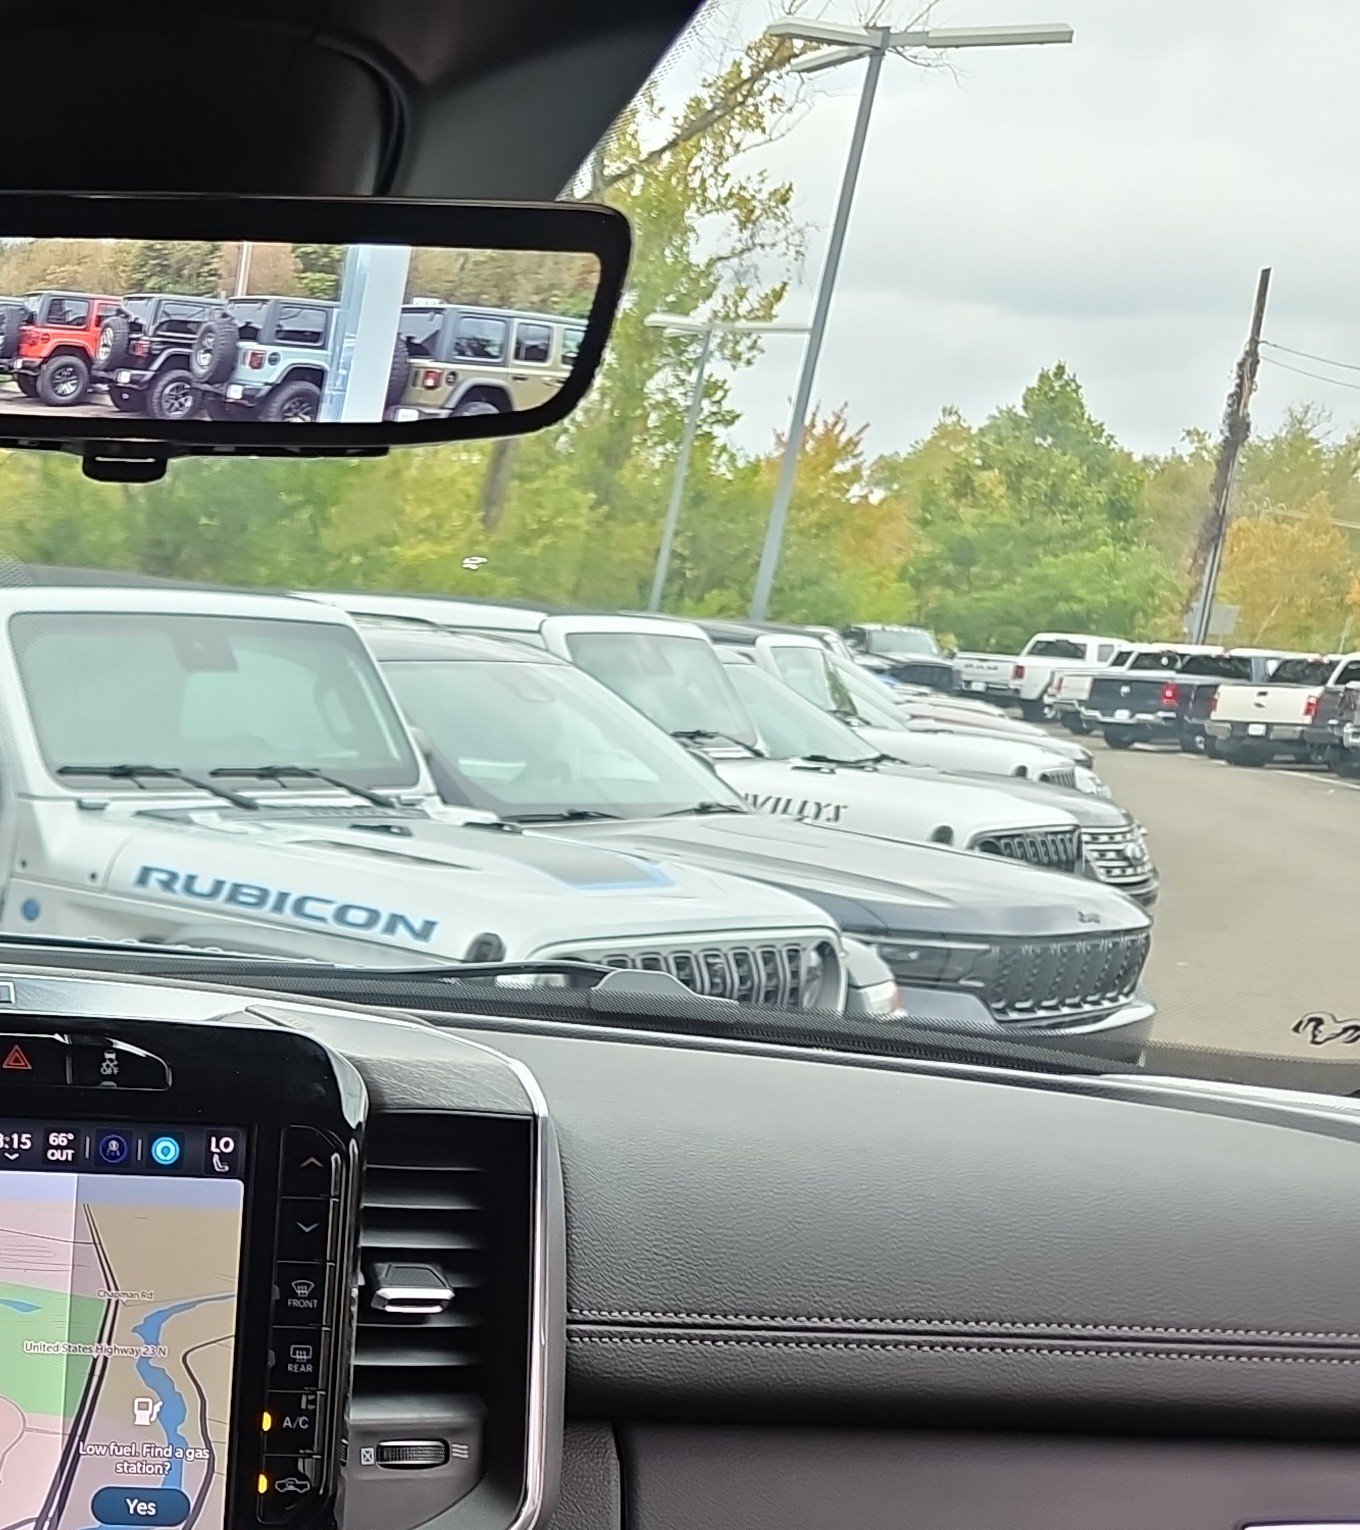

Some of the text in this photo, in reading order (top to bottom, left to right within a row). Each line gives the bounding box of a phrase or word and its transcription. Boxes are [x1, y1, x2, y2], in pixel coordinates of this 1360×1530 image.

[134, 865, 439, 944] RUBICON
[210, 1136, 235, 1153] LO
[47, 1149, 75, 1161] OUT
[97, 1290, 154, 1301] Chapman Rd
[287, 1299, 318, 1309] FRONT
[24, 1341, 168, 1357] United States Highway 23 N
[287, 1364, 313, 1373] REAR
[282, 1416, 309, 1429] A/C
[79, 1441, 210, 1460] Low fuel. Find a gas
[115, 1461, 170, 1475] station?
[126, 1498, 157, 1516] Yes
